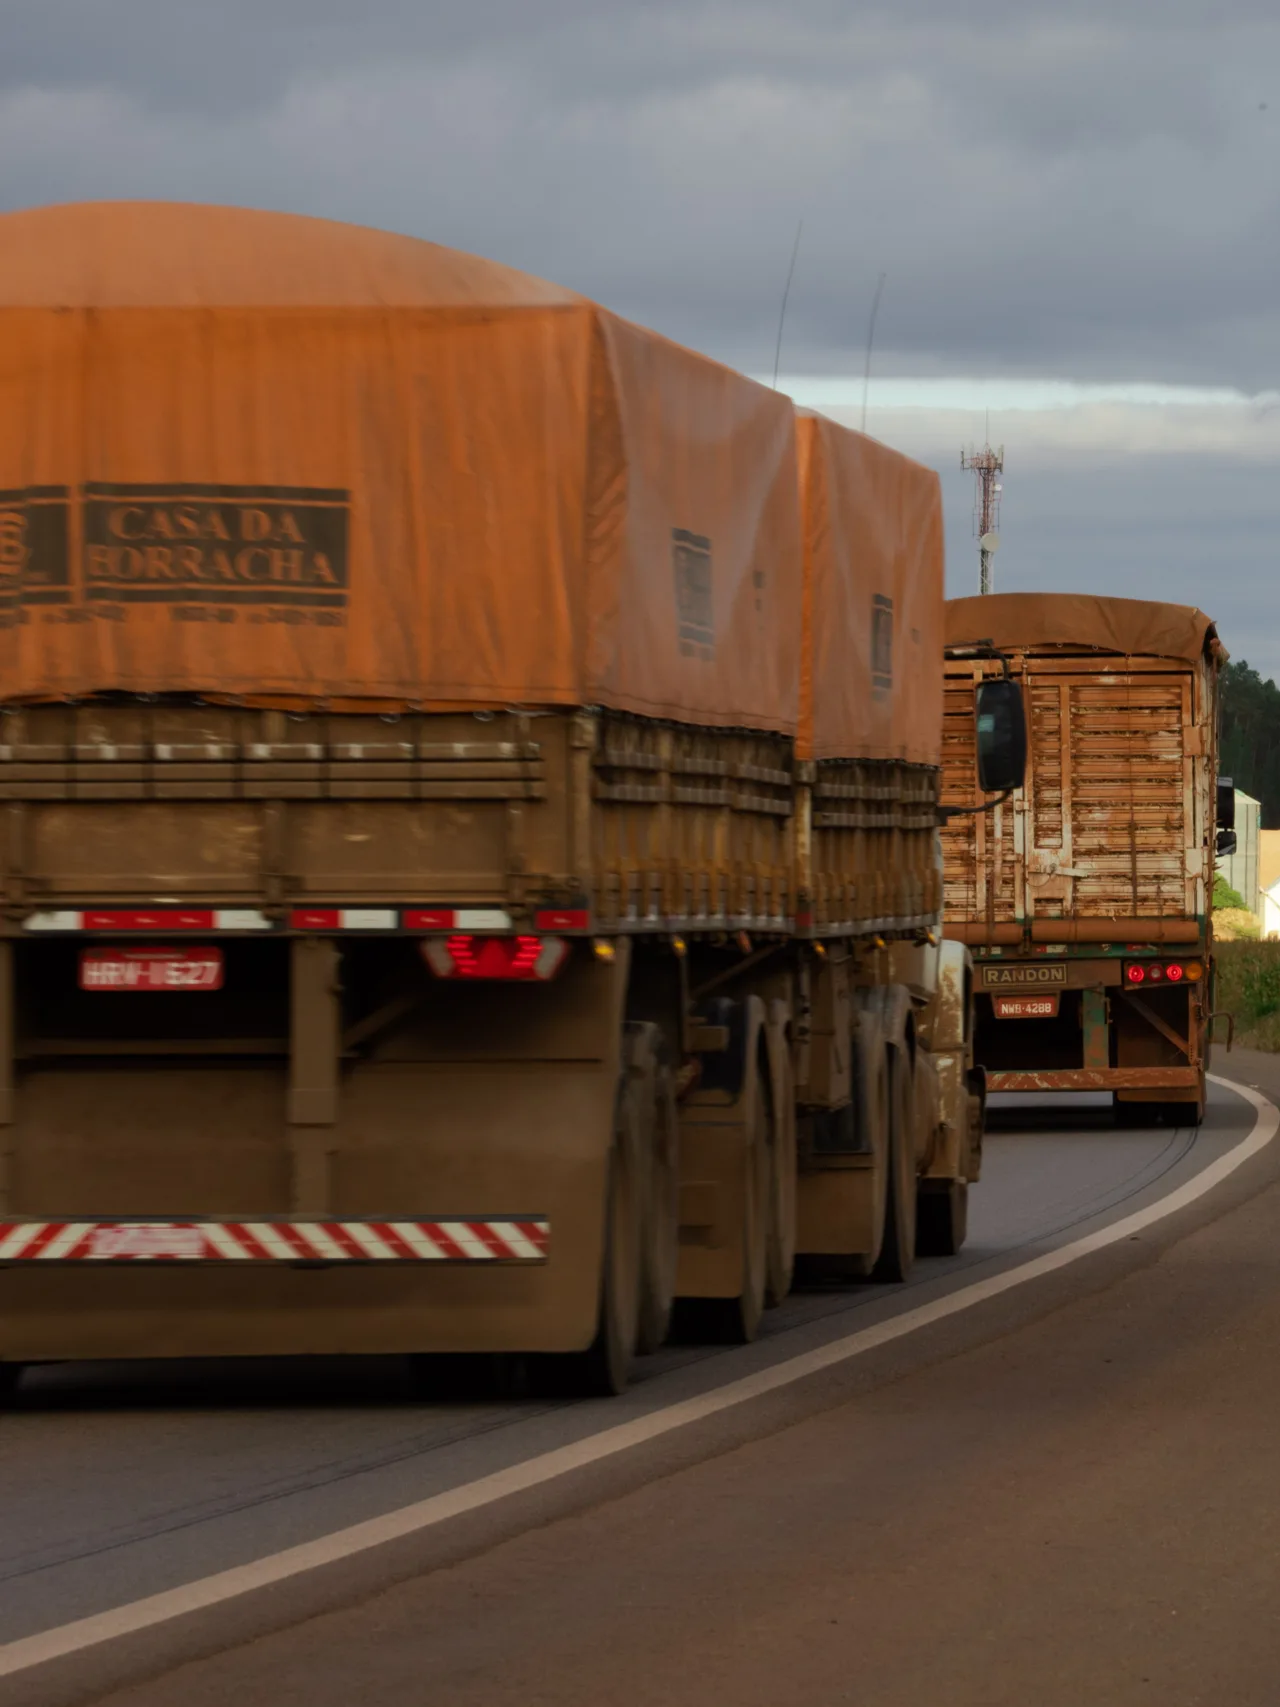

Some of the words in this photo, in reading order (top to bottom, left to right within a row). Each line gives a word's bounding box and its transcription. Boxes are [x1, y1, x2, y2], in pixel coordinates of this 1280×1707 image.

[108, 506, 230, 541] CASA
[239, 508, 306, 543] DA
[987, 967, 1063, 982] RANDON
